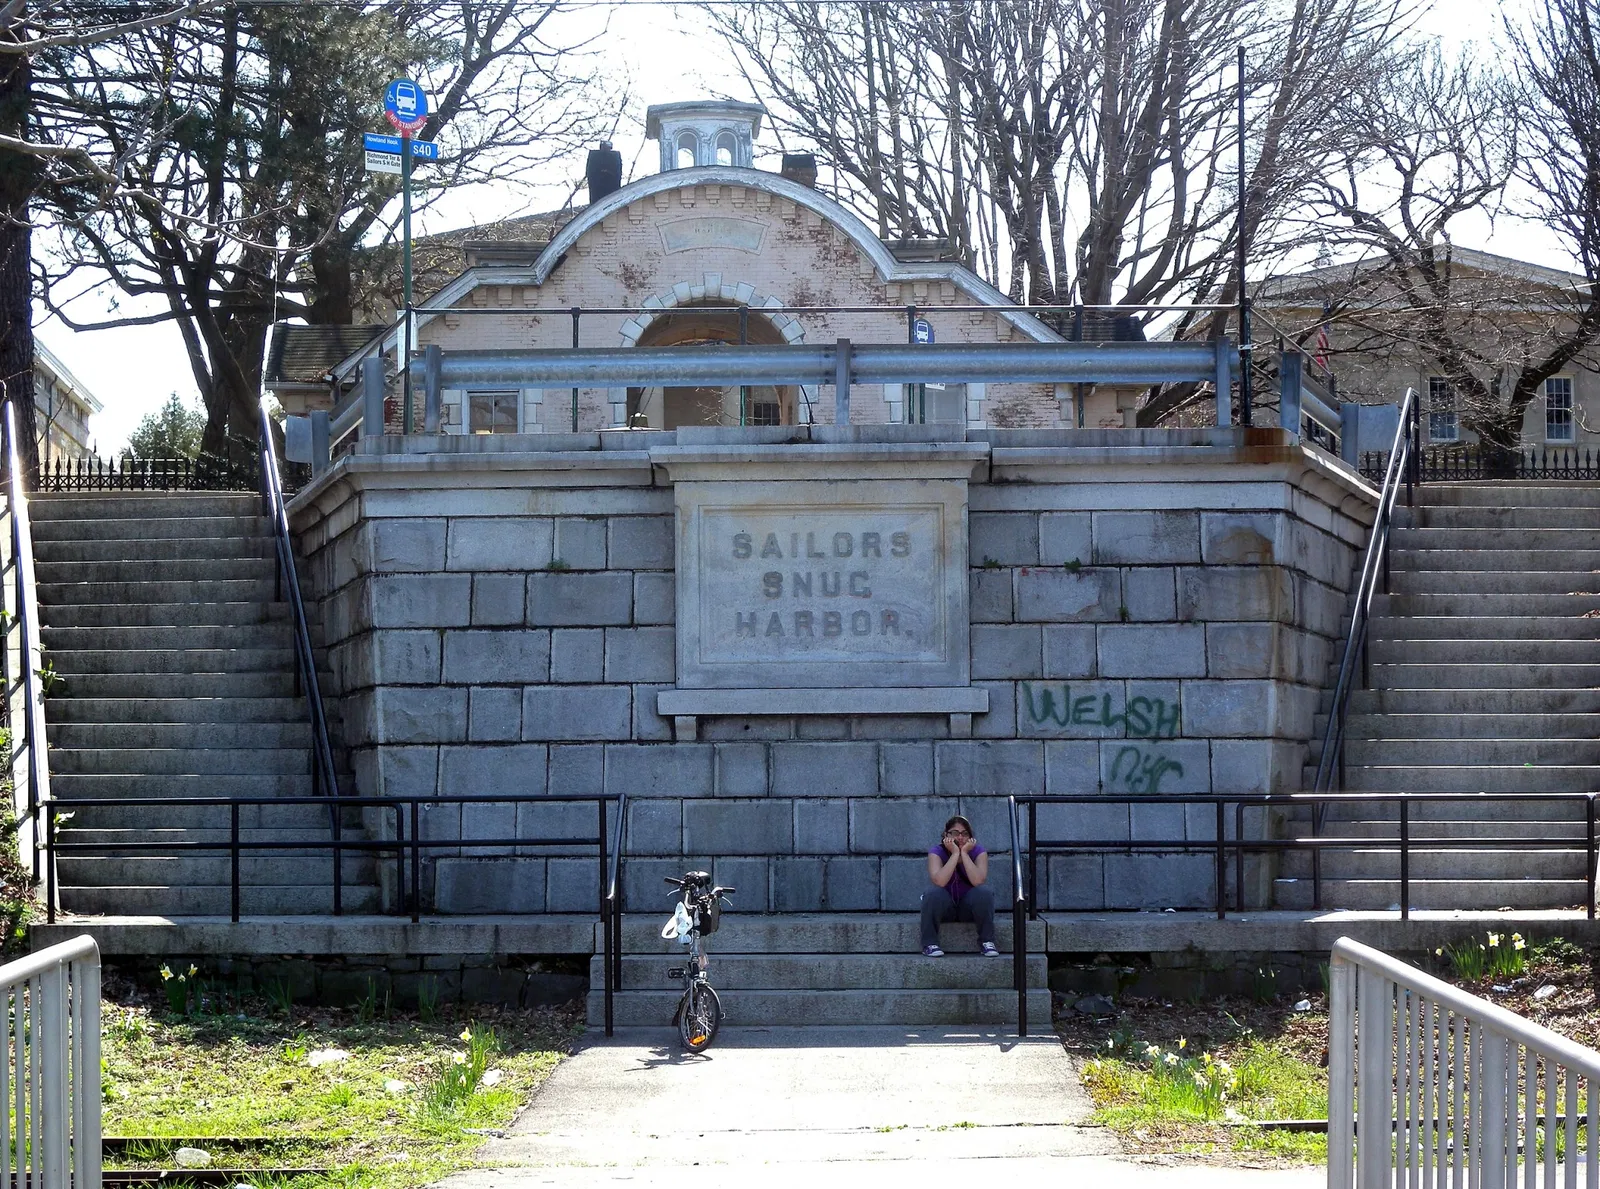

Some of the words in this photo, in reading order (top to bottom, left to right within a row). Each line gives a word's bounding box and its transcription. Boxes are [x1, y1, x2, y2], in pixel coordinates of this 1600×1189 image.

[389, 113, 398, 123] NO
[398, 118, 423, 130] STANDING
[366, 135, 386, 144] Howland
[413, 144, 432, 157] S40
[366, 151, 388, 159] Richmond
[732, 531, 912, 560] SAILORS
[762, 571, 873, 599] SNUG
[735, 608, 915, 638] HARBOR.
[1022, 681, 1180, 738] WELSH
